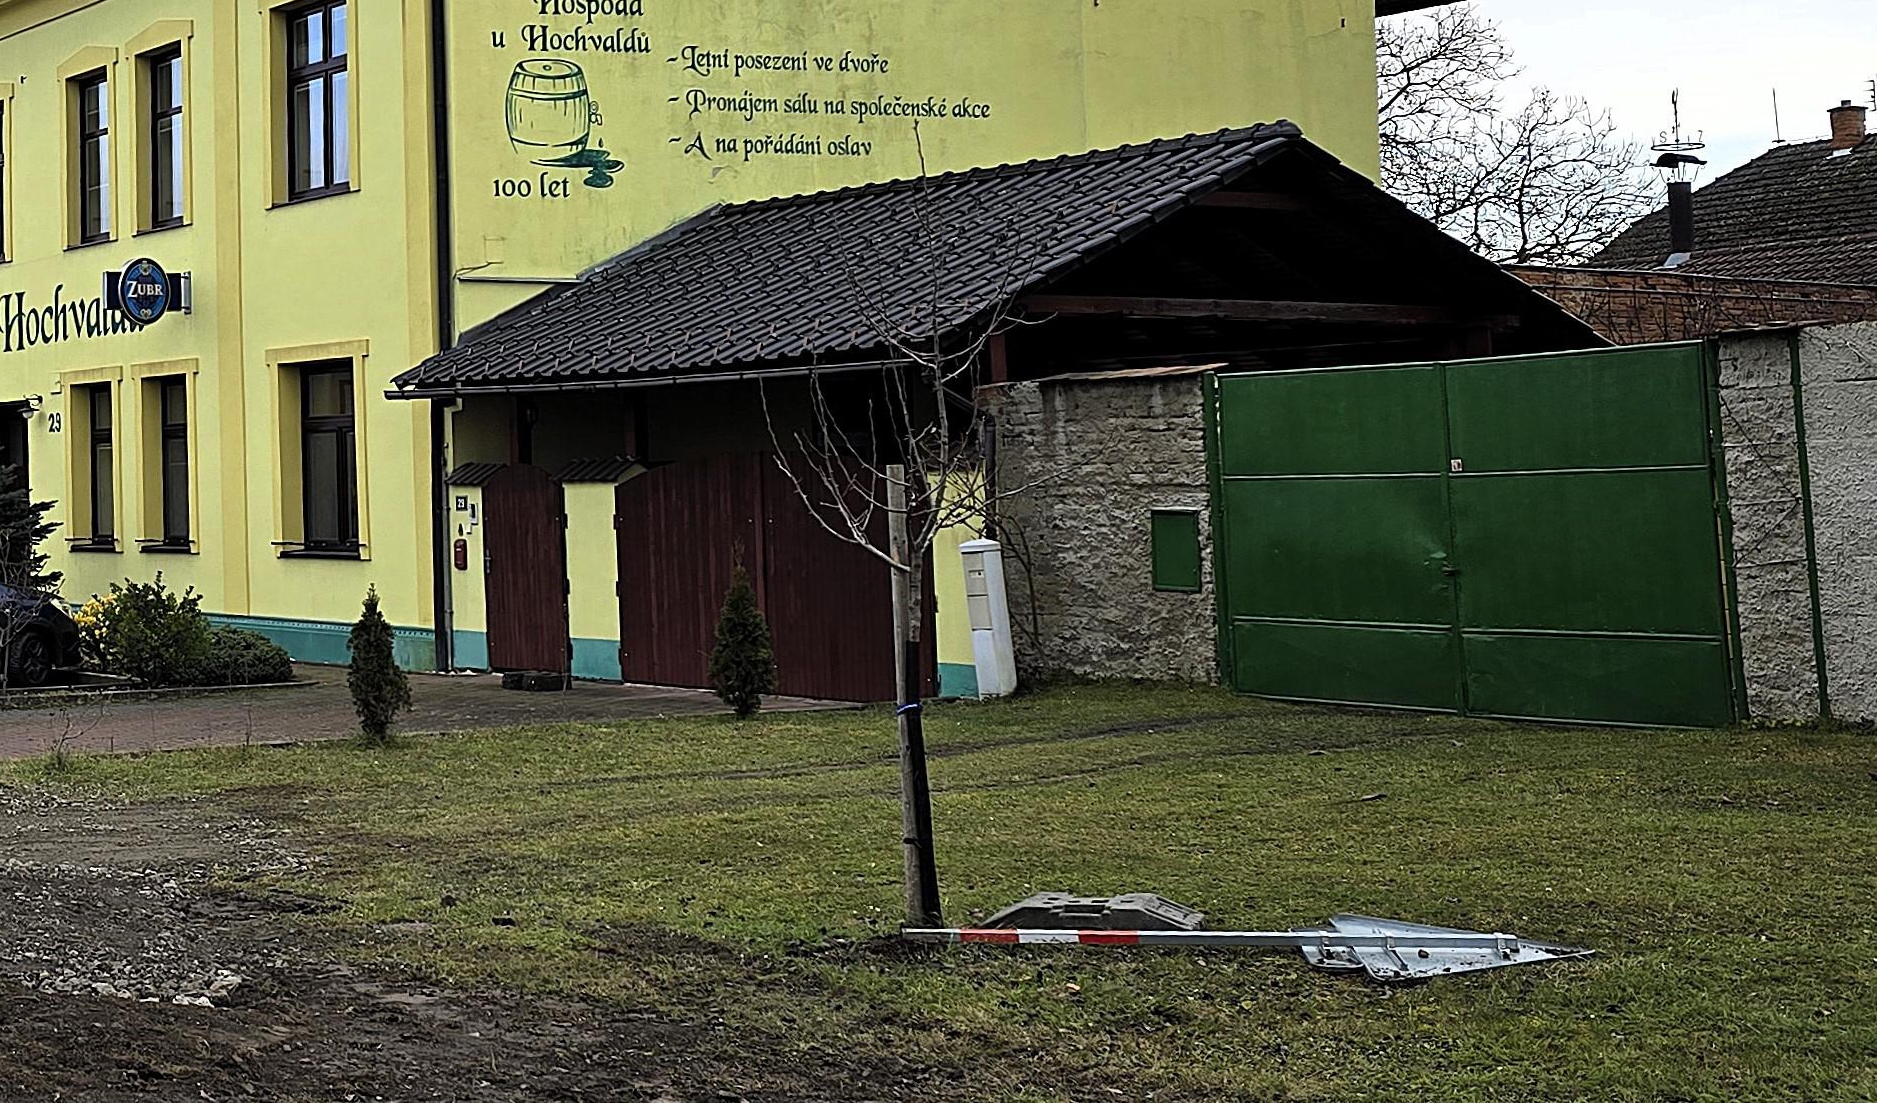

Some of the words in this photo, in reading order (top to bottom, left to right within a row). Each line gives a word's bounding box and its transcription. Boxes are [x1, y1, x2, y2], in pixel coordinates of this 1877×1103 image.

[491, 30, 506, 48] u
[521, 24, 652, 54] Hochvaldů
[734, 50, 808, 78] posezení
[813, 56, 834, 72] ve
[838, 50, 889, 74] dvoře
[685, 89, 778, 122] Pronájem
[783, 92, 819, 114] sálu
[824, 100, 846, 115] na
[850, 95, 948, 124] společenské
[952, 97, 991, 119] akce
[684, 131, 713, 161] A
[715, 137, 738, 153] na
[742, 133, 822, 162] pořádání
[827, 135, 873, 157] oslav
[493, 179, 532, 198] 100
[539, 171, 571, 199] let
[126, 280, 164, 298] ZUBR
[48, 412, 62, 433] 29
